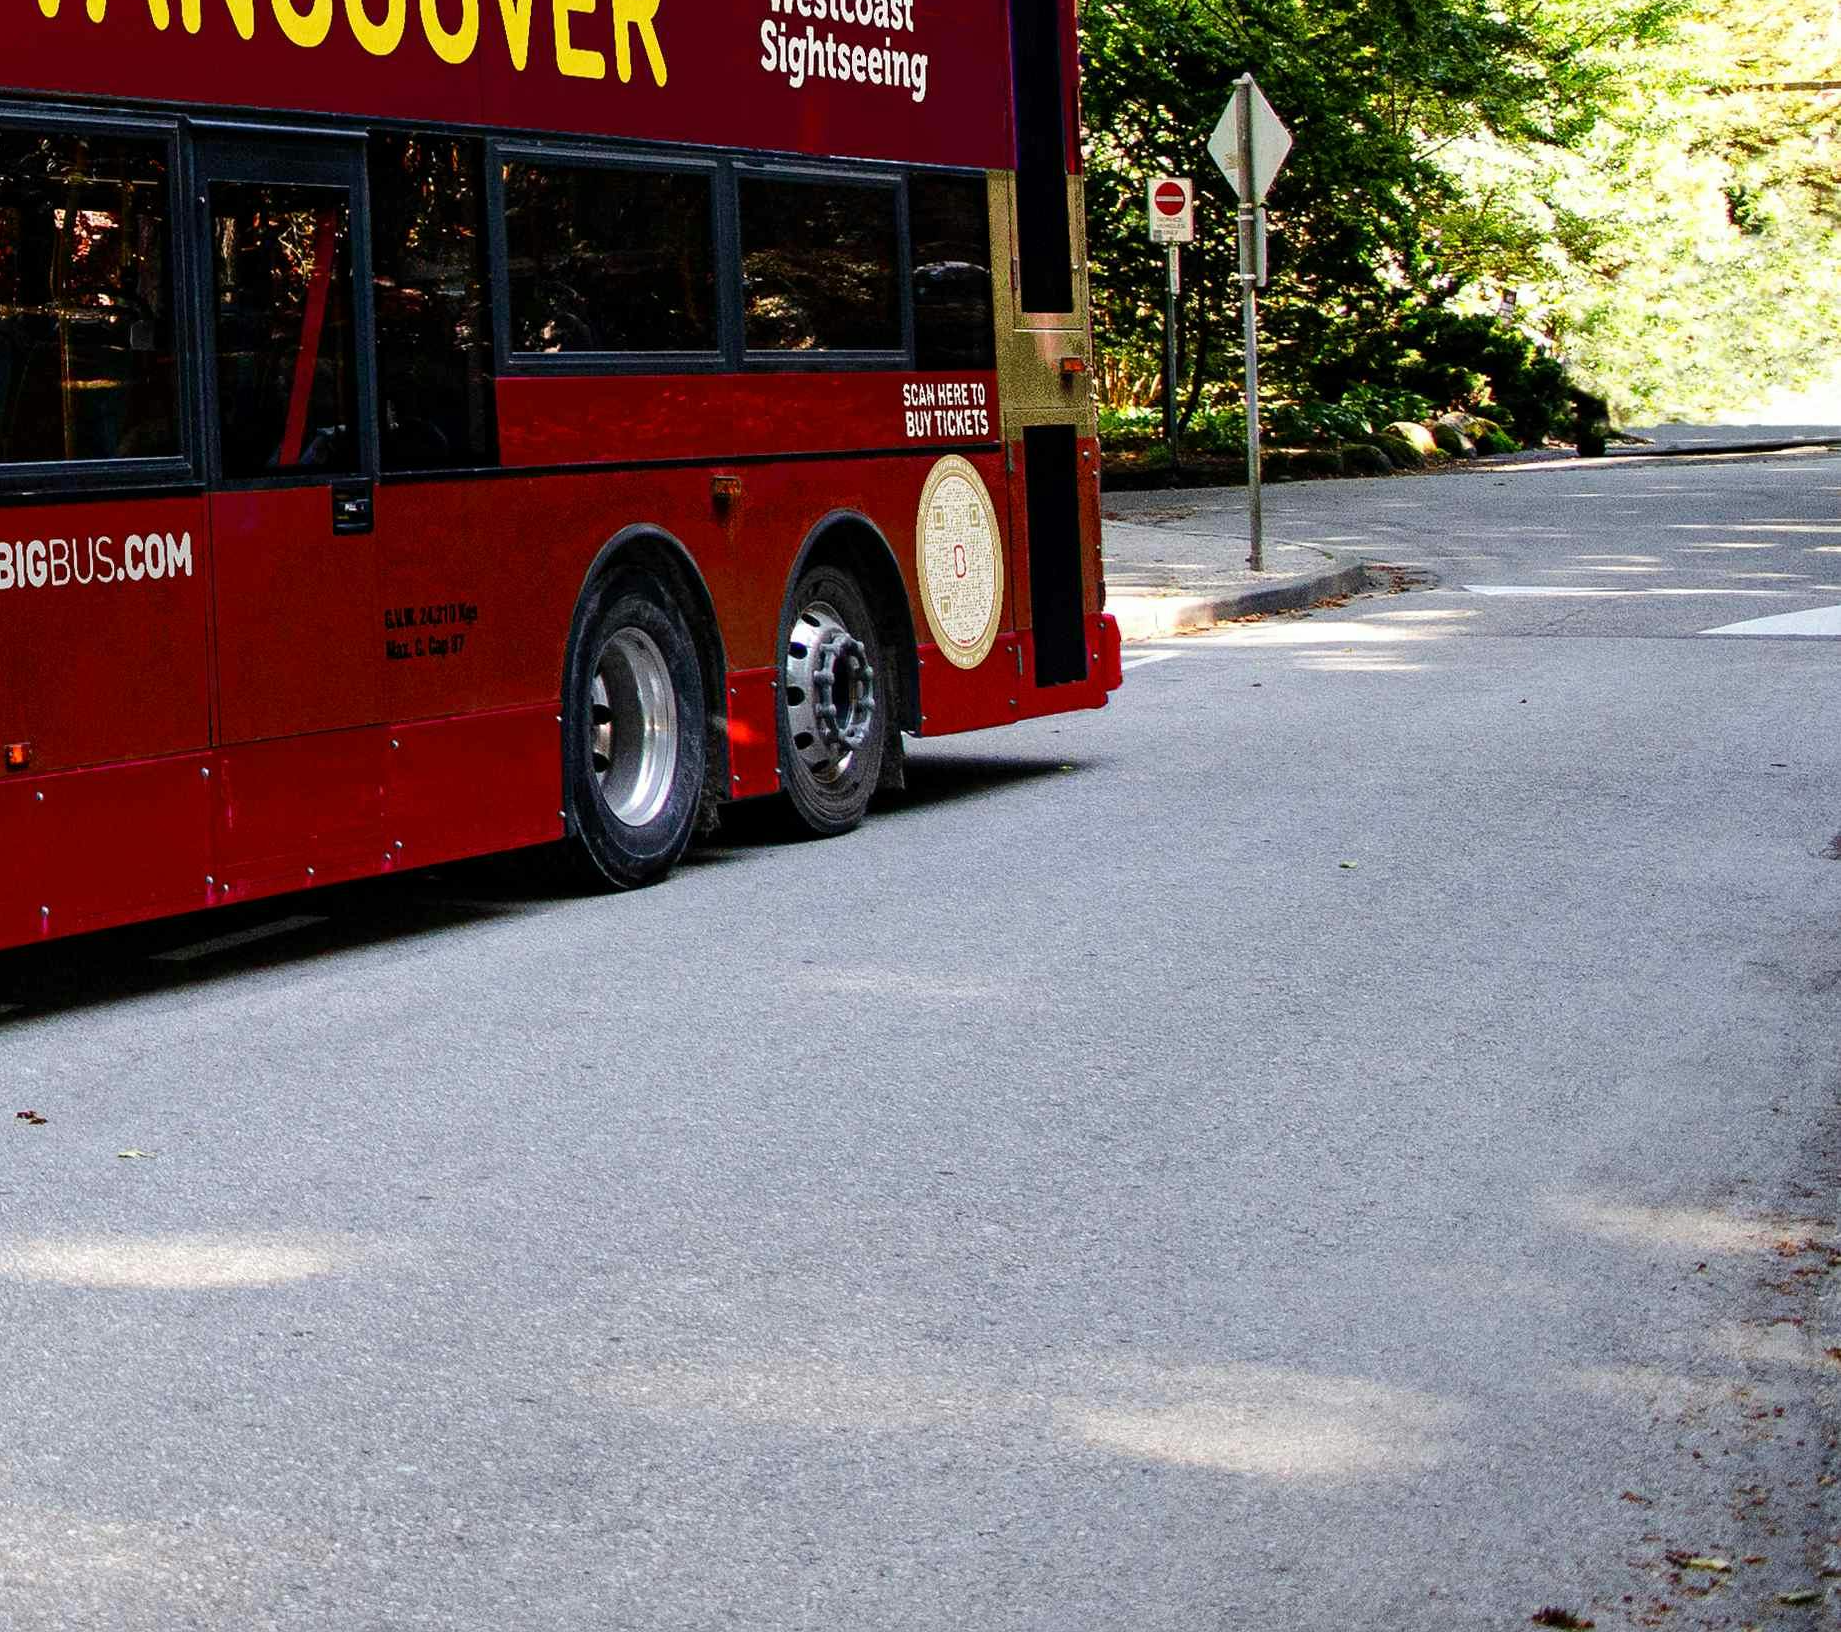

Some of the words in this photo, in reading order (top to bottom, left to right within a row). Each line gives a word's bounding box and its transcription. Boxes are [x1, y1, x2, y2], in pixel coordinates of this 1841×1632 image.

[760, 19, 928, 103] Sightseeing
[902, 382, 936, 407] SCAN
[937, 383, 970, 406] HERE
[970, 382, 986, 406] TO
[904, 410, 932, 438] BUY
[933, 409, 990, 437] TICKETS
